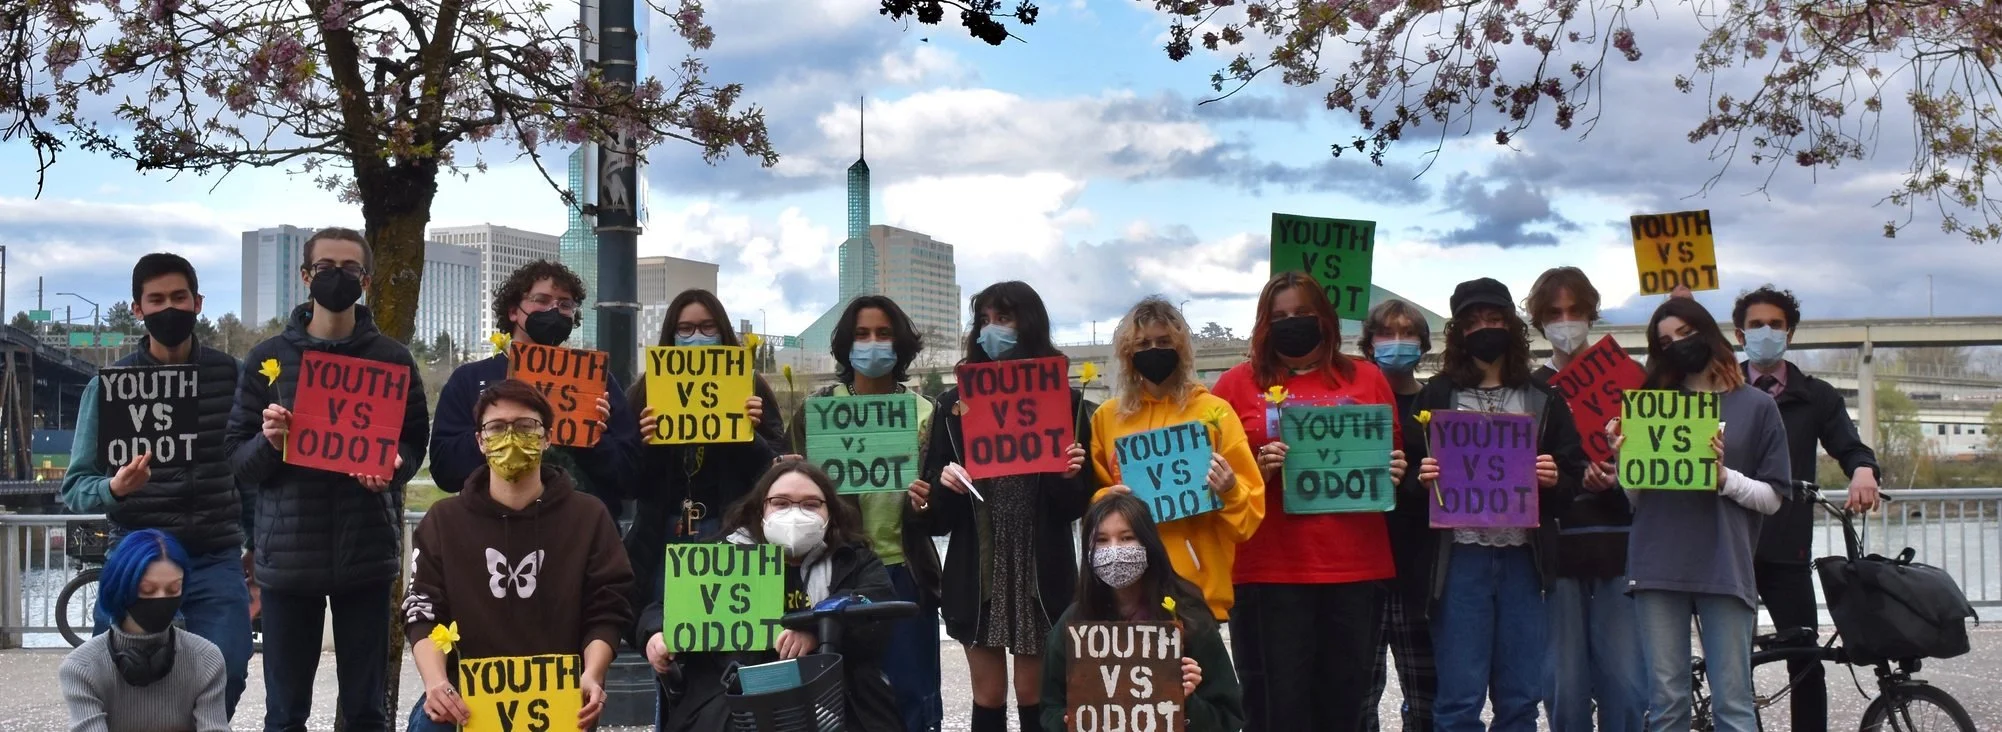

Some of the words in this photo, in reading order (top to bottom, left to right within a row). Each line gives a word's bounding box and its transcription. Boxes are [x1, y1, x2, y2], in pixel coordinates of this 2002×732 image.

[1280, 220, 1369, 252] YOUTH
[1630, 210, 1712, 240] YOUTH
[1302, 251, 1341, 279] VS
[1656, 241, 1694, 264] VS
[1641, 264, 1717, 293] ODOT
[1324, 284, 1363, 312] OT
[511, 344, 609, 383] YOUTH
[650, 349, 745, 376] YOUTH
[1557, 339, 1627, 399] OUTH
[101, 370, 198, 402] YOUTH
[305, 359, 406, 400] YOUTH
[676, 382, 719, 408] VS
[960, 362, 1061, 398] YOUTH
[535, 381, 577, 412] VS
[1582, 381, 1622, 416] VS
[1622, 391, 1718, 419] YOUTH
[128, 402, 173, 432] VS
[328, 397, 373, 429] VS
[656, 412, 743, 440] ODOT
[813, 400, 907, 430] YOUTH
[991, 398, 1037, 428] VS
[1288, 411, 1385, 441] YOUTH
[297, 428, 395, 466] ODOT
[556, 418, 597, 445] OT
[972, 428, 1065, 465] ODOT
[1115, 423, 1212, 466] YOUTH
[1436, 420, 1532, 448] YOUTH
[1648, 425, 1692, 453] VS
[108, 433, 198, 466] ODOT
[821, 455, 910, 489] ODOT
[1146, 459, 1191, 490] VS
[1462, 454, 1505, 481] VS
[1626, 457, 1717, 486] ODOT
[1296, 468, 1386, 501] ODOT
[1440, 486, 1532, 513] ODOT
[1154, 484, 1217, 521] DOT
[668, 544, 781, 577] YOUTH
[700, 583, 751, 615] VS
[673, 618, 783, 652] ODOT
[1068, 625, 1181, 660] YOUTH
[460, 656, 580, 696] YOUTH
[1100, 665, 1153, 699] VS
[496, 698, 550, 732] VS
[1076, 701, 1180, 732] ODOT
